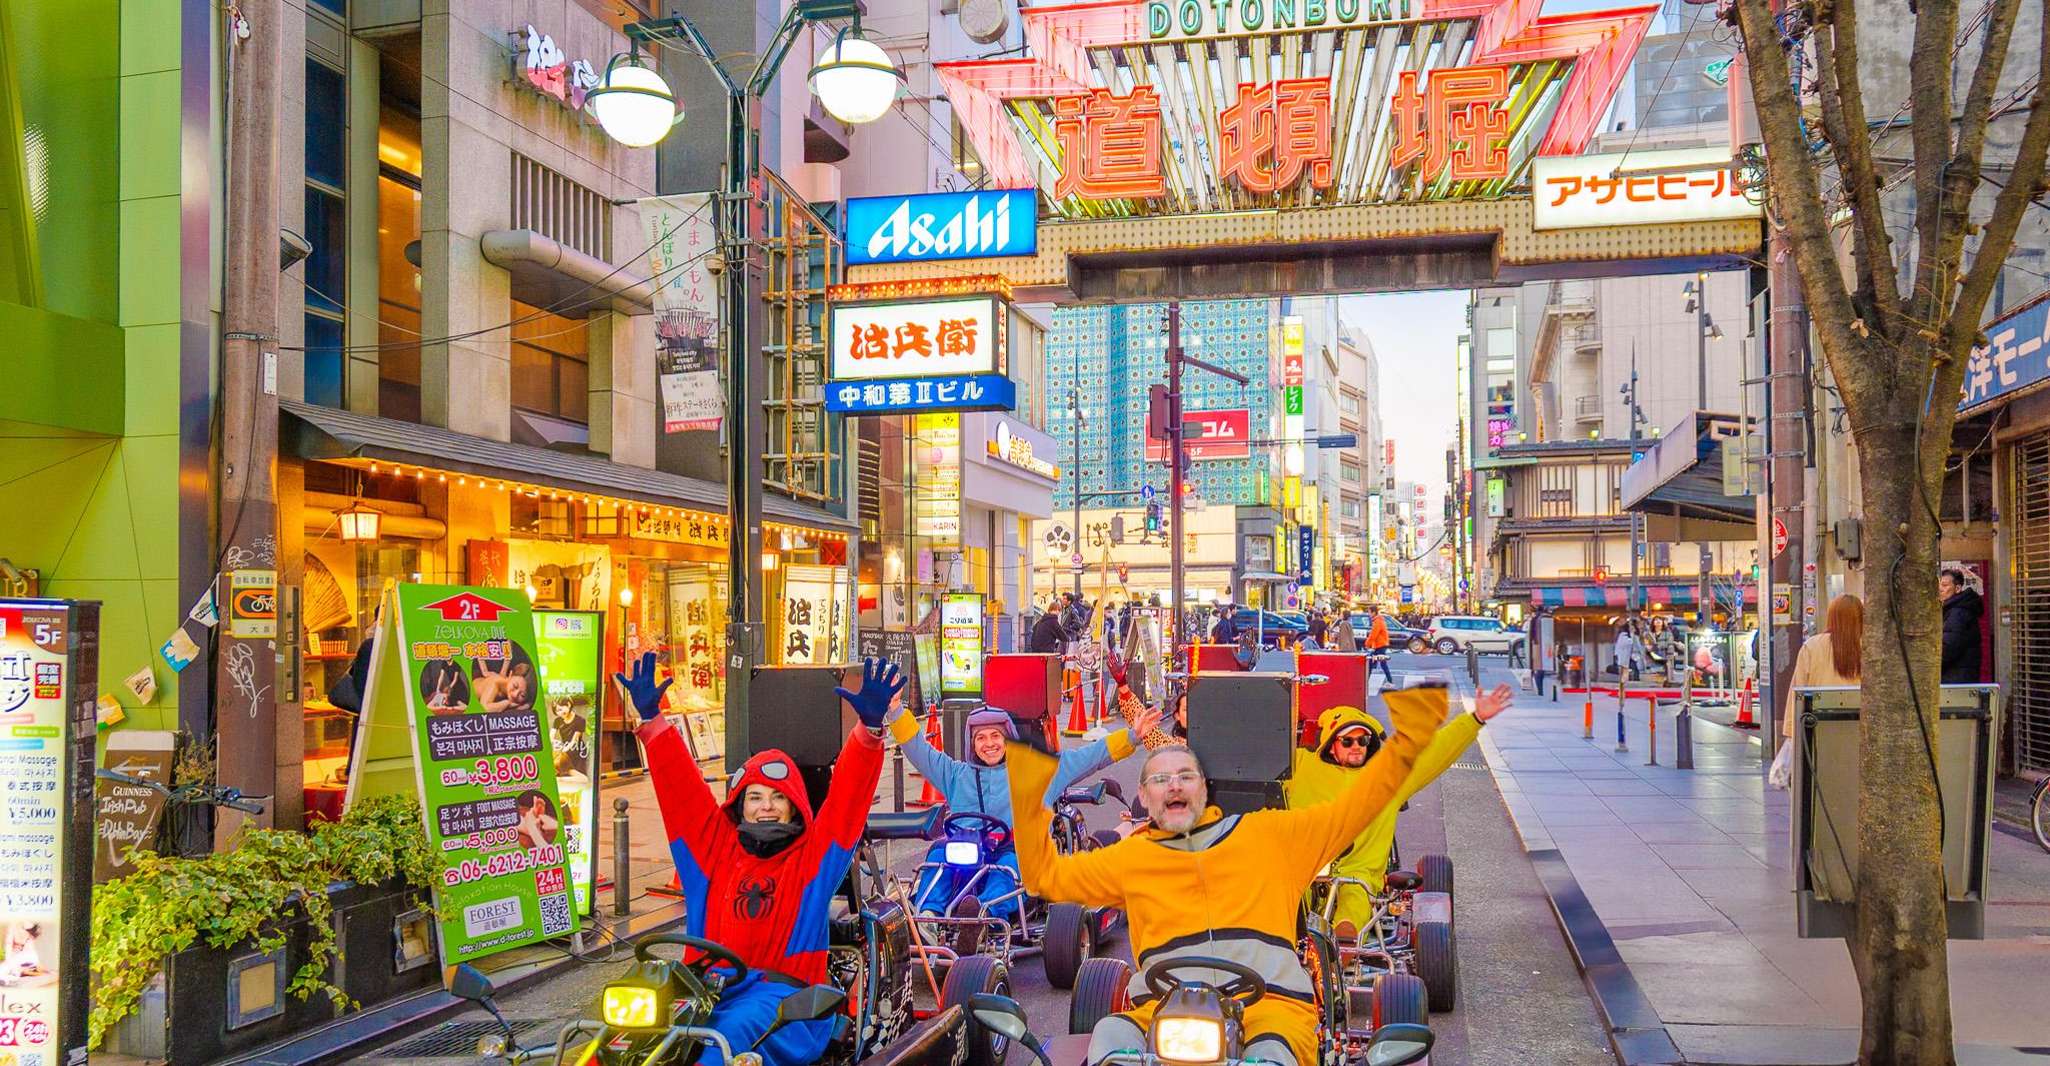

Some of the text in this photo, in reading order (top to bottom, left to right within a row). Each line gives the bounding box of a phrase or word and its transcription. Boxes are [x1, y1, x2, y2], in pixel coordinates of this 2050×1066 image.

[1150, 0, 1411, 38] DOTONBORI
[1055, 63, 1510, 202] 道頓堀
[868, 193, 1010, 258] Asahi
[850, 317, 978, 361] 治兵衛
[1960, 306, 2050, 402] 洋モー
[460, 599, 480, 620] 2F
[35, 623, 61, 646] 5F
[786, 598, 812, 664] 治兵
[431, 720, 483, 735] もみほぐし
[489, 715, 536, 730] MASSAGE
[436, 739, 484, 756] 본격 마사지
[493, 734, 538, 751] 正宗按摩
[468, 754, 539, 786] ¥3,800
[113, 786, 153, 797] GUINNESS
[124, 798, 148, 815] Pub
[440, 804, 473, 820] 足ツボ
[476, 798, 516, 814] FOOT MASSAGE
[452, 820, 475, 833] 마사지
[465, 828, 519, 849] ¥5,000
[461, 845, 565, 881] 06-6212-7401
[537, 869, 564, 887] 24H
[469, 901, 516, 921] FOREST
